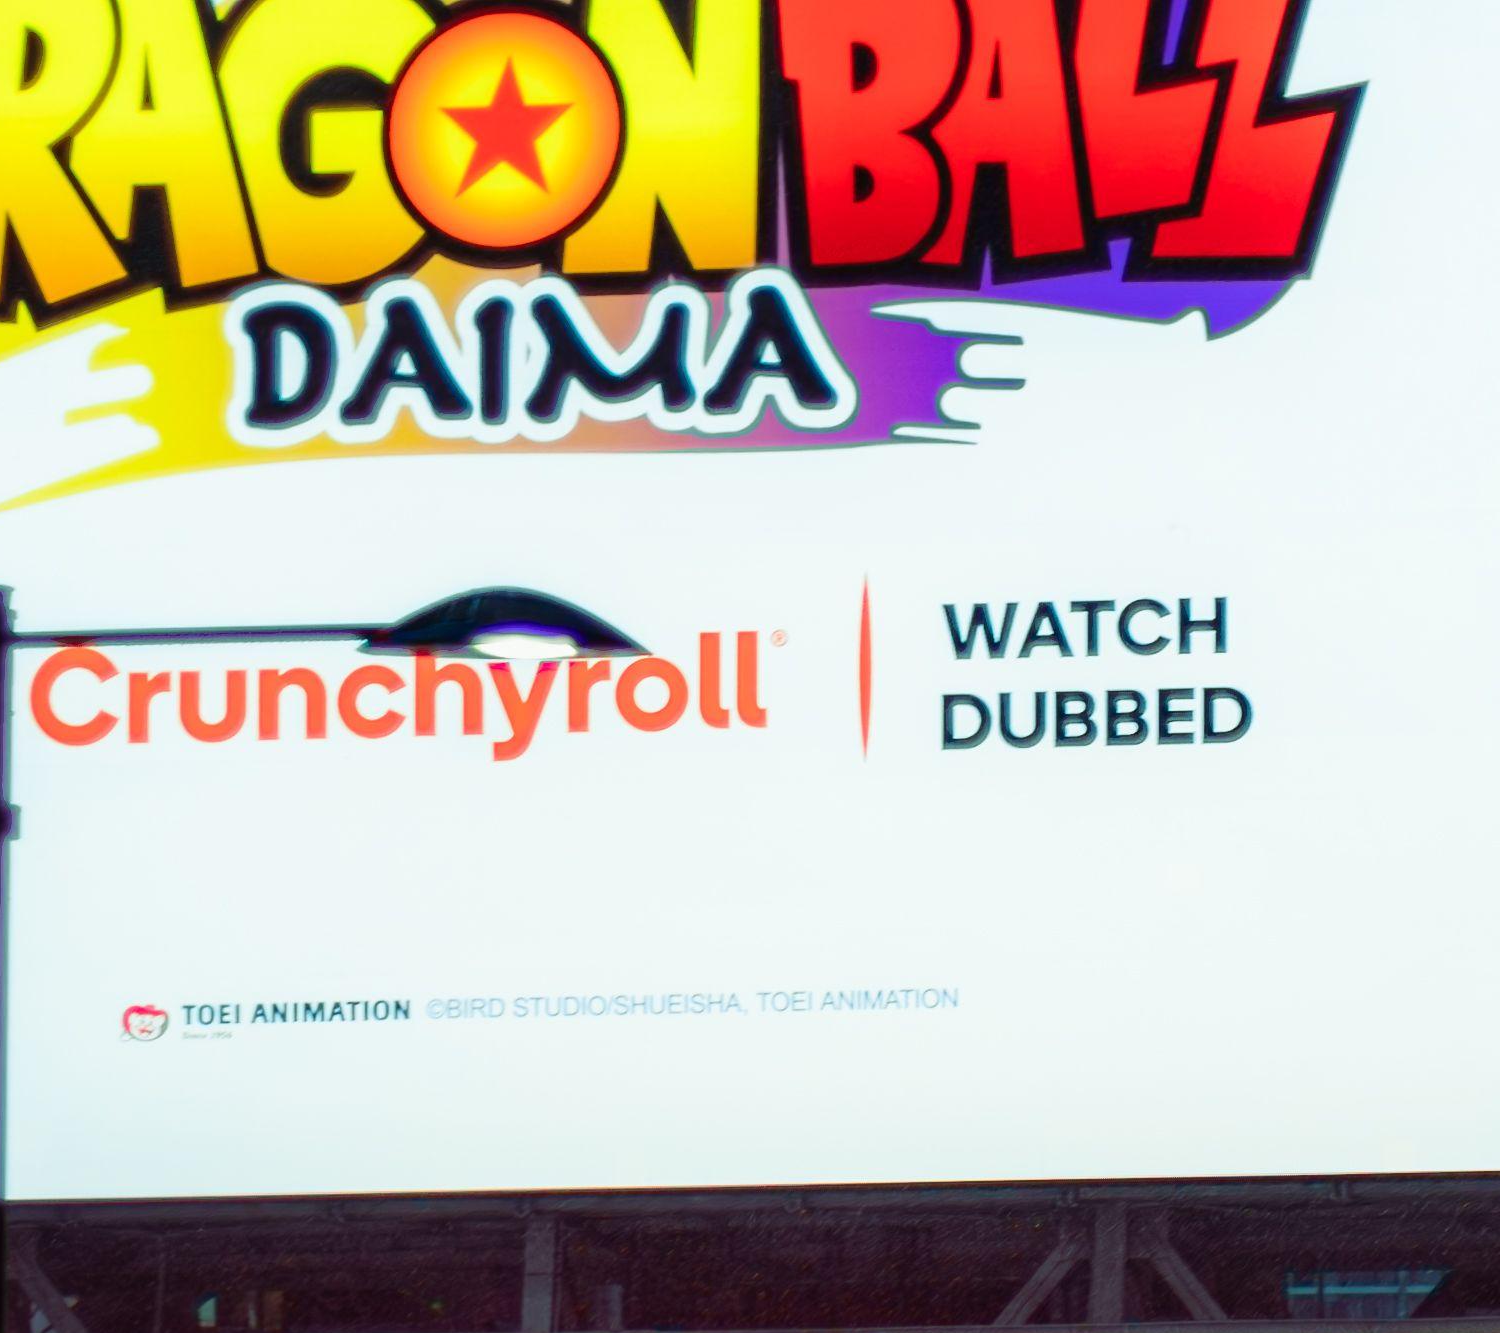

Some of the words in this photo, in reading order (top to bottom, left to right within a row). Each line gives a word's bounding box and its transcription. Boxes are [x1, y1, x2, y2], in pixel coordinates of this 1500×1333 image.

[240, 285, 840, 430] DAIMA
[941, 595, 1229, 662] WATCH
[32, 630, 768, 762] Crunchyroll
[939, 685, 1253, 752] DUBBED
[182, 1003, 242, 1027] TOEI
[251, 999, 412, 1024] ANIMATION
[757, 990, 814, 1013] TOEI
[820, 987, 959, 1011] ANIMATION
